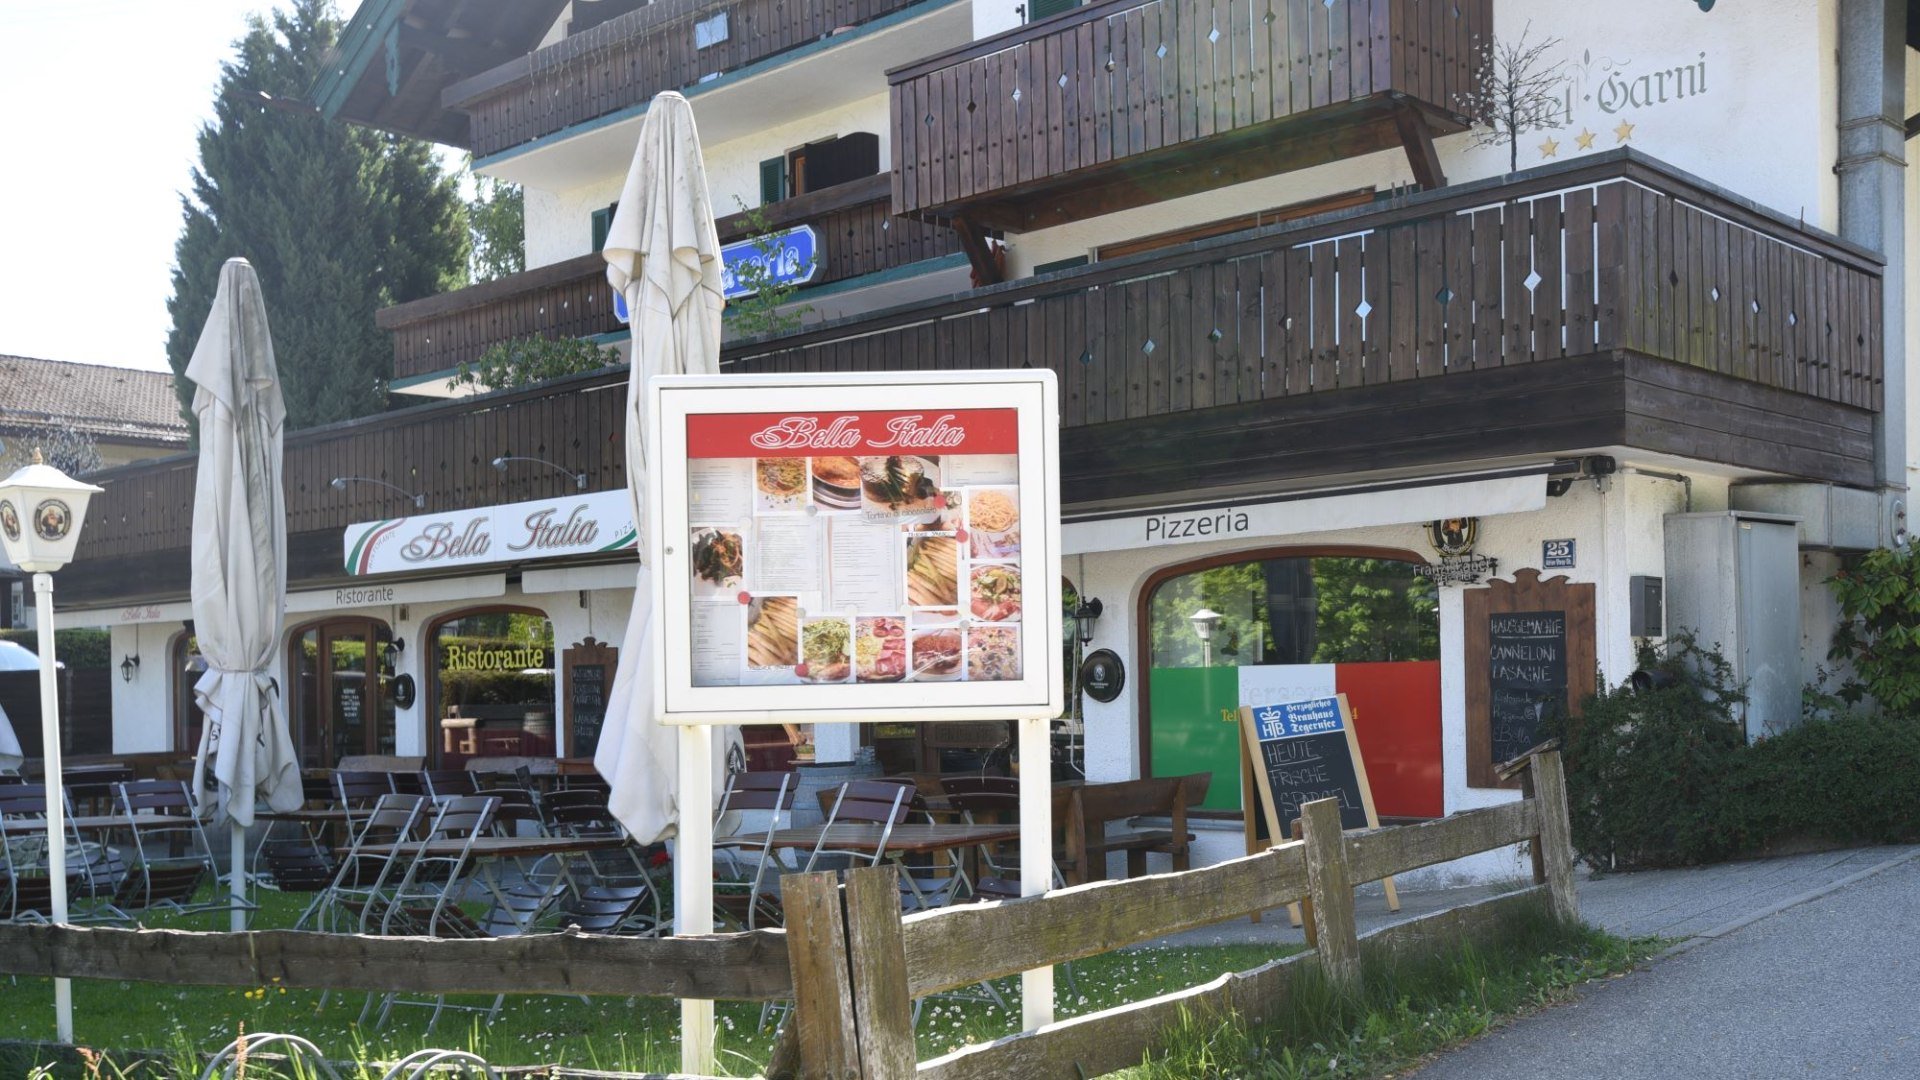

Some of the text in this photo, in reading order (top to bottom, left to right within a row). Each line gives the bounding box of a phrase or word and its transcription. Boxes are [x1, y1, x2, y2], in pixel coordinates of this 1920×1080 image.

[1598, 51, 1708, 114] Garni
[750, 414, 965, 449] Bella Italia
[401, 503, 599, 562] Bella Italia
[614, 519, 634, 539] PIZZ
[1145, 508, 1249, 541] Pizzeria
[1546, 541, 1570, 556] 25
[335, 586, 395, 605] Ristorante
[446, 644, 545, 671] Ristorante
[1491, 664, 1553, 683] LASAGNE
[1288, 710, 1335, 723] Brauhaus
